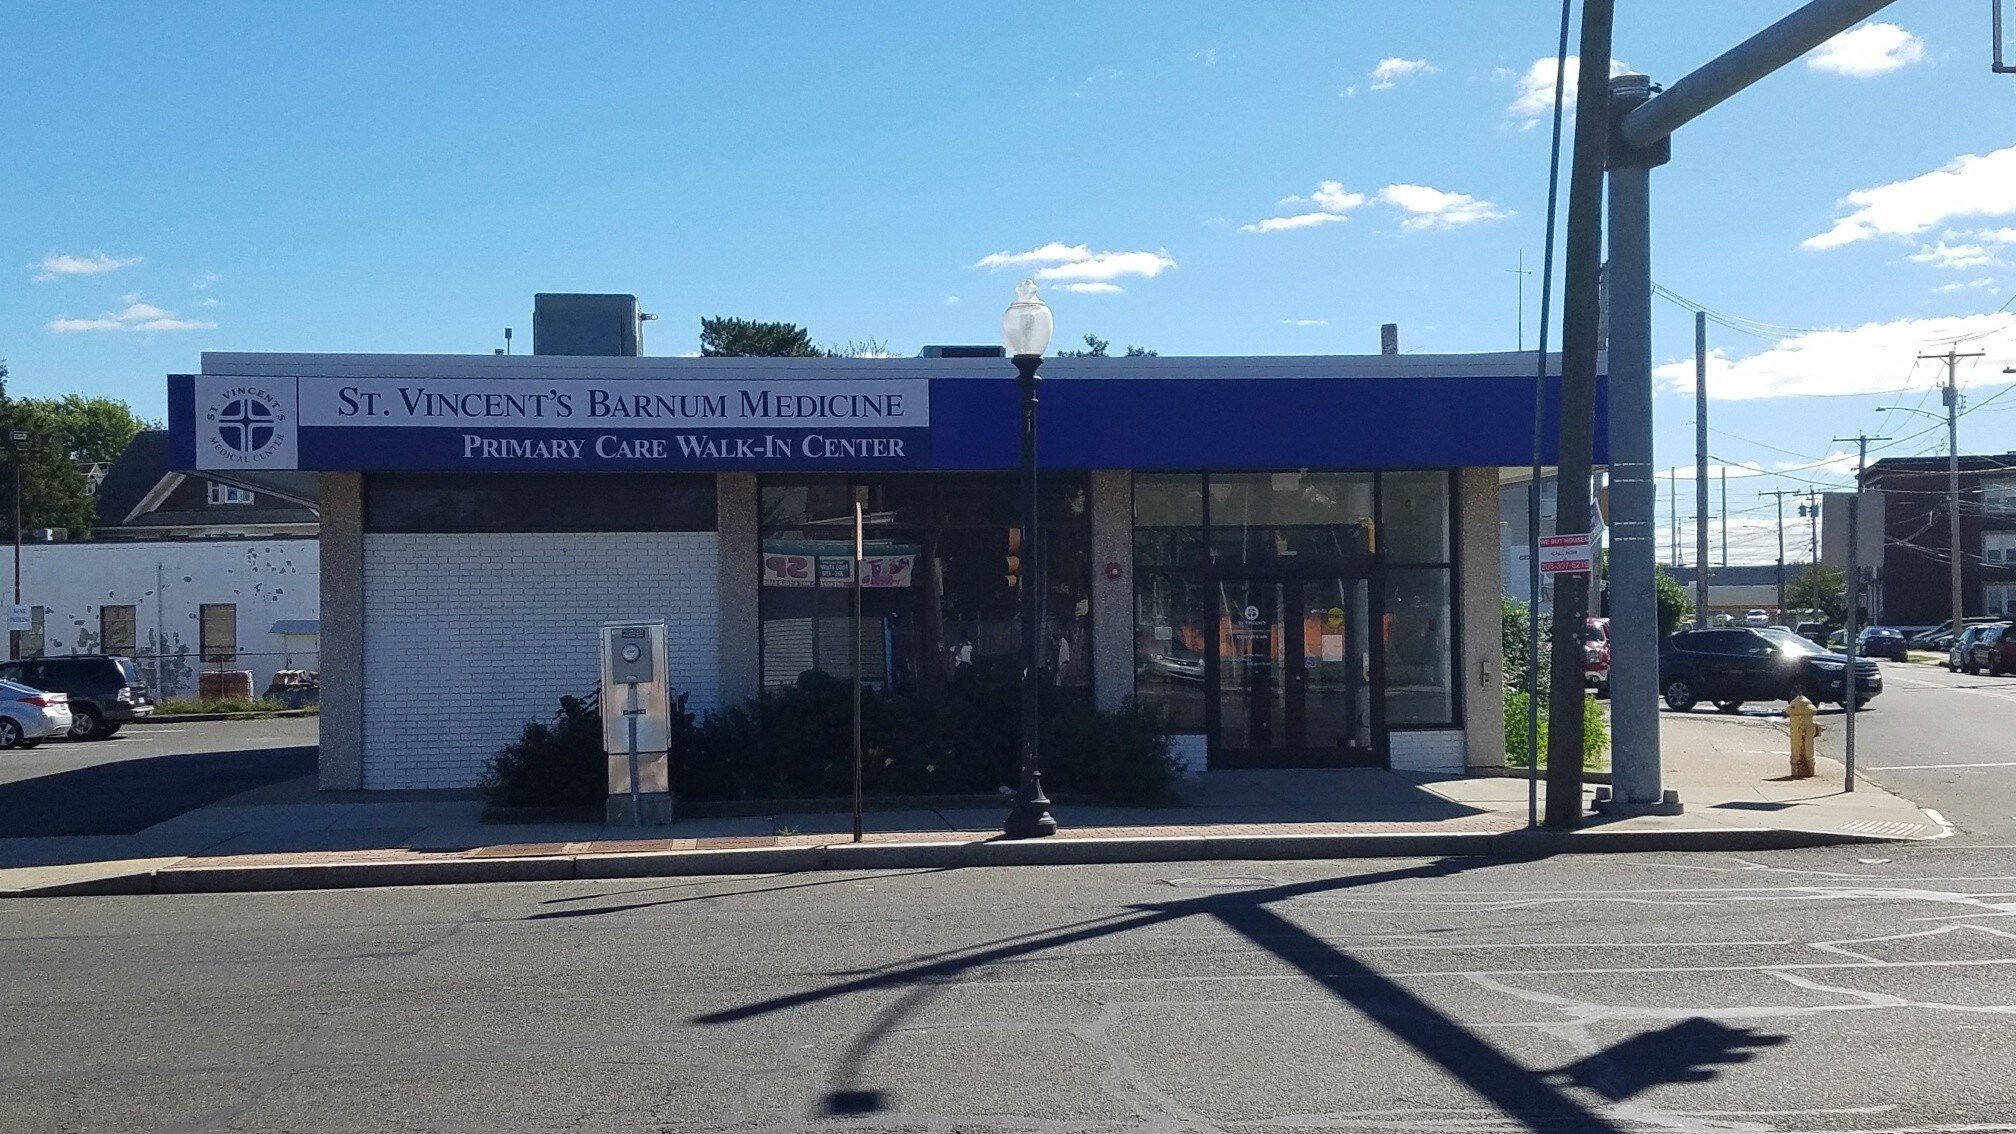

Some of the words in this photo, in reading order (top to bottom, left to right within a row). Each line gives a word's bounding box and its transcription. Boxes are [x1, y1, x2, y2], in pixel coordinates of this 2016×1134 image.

[206, 403, 221, 421] ST.
[222, 386, 286, 421] VINCENT'S
[338, 386, 390, 416] ST.
[397, 387, 573, 417] VINCENT'S
[587, 389, 728, 418] BARNUM
[738, 390, 905, 418] MEDICINE
[209, 436, 250, 463] MEDICAL
[253, 434, 285, 462] CENTER
[462, 434, 586, 459] PRIMARY
[595, 434, 667, 459] CARE
[676, 434, 792, 459] WALK-IN
[802, 434, 906, 458] CENTER
